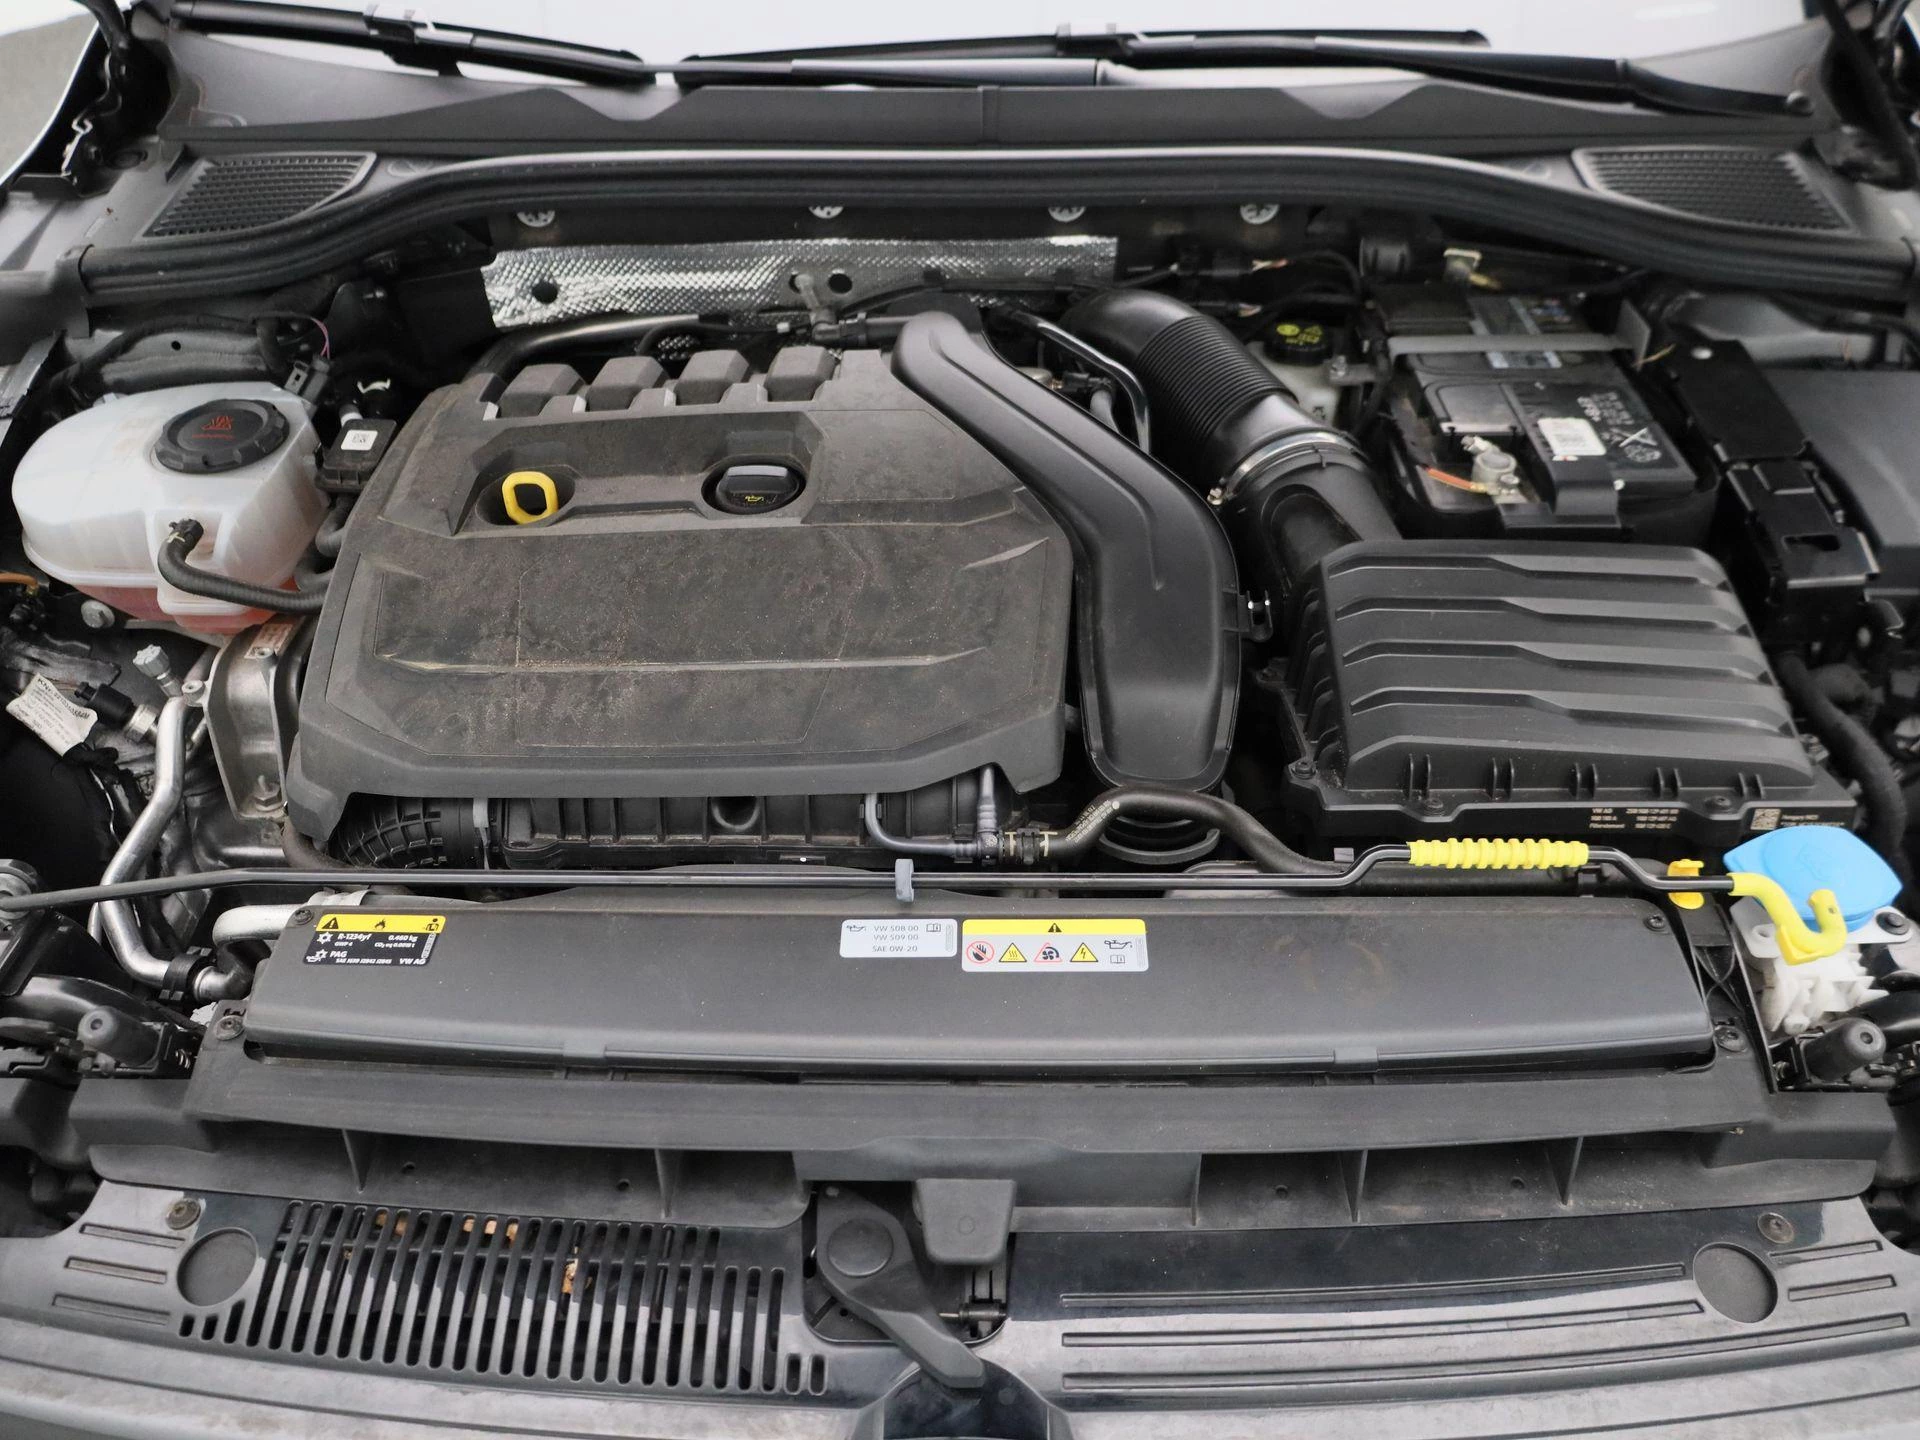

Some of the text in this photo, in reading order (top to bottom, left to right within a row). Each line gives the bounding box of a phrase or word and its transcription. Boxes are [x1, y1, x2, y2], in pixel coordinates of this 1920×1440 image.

[337, 933, 372, 942] R-1234yf
[408, 934, 418, 943] kg
[329, 950, 348, 958] PAG
[399, 957, 414, 965] VW
